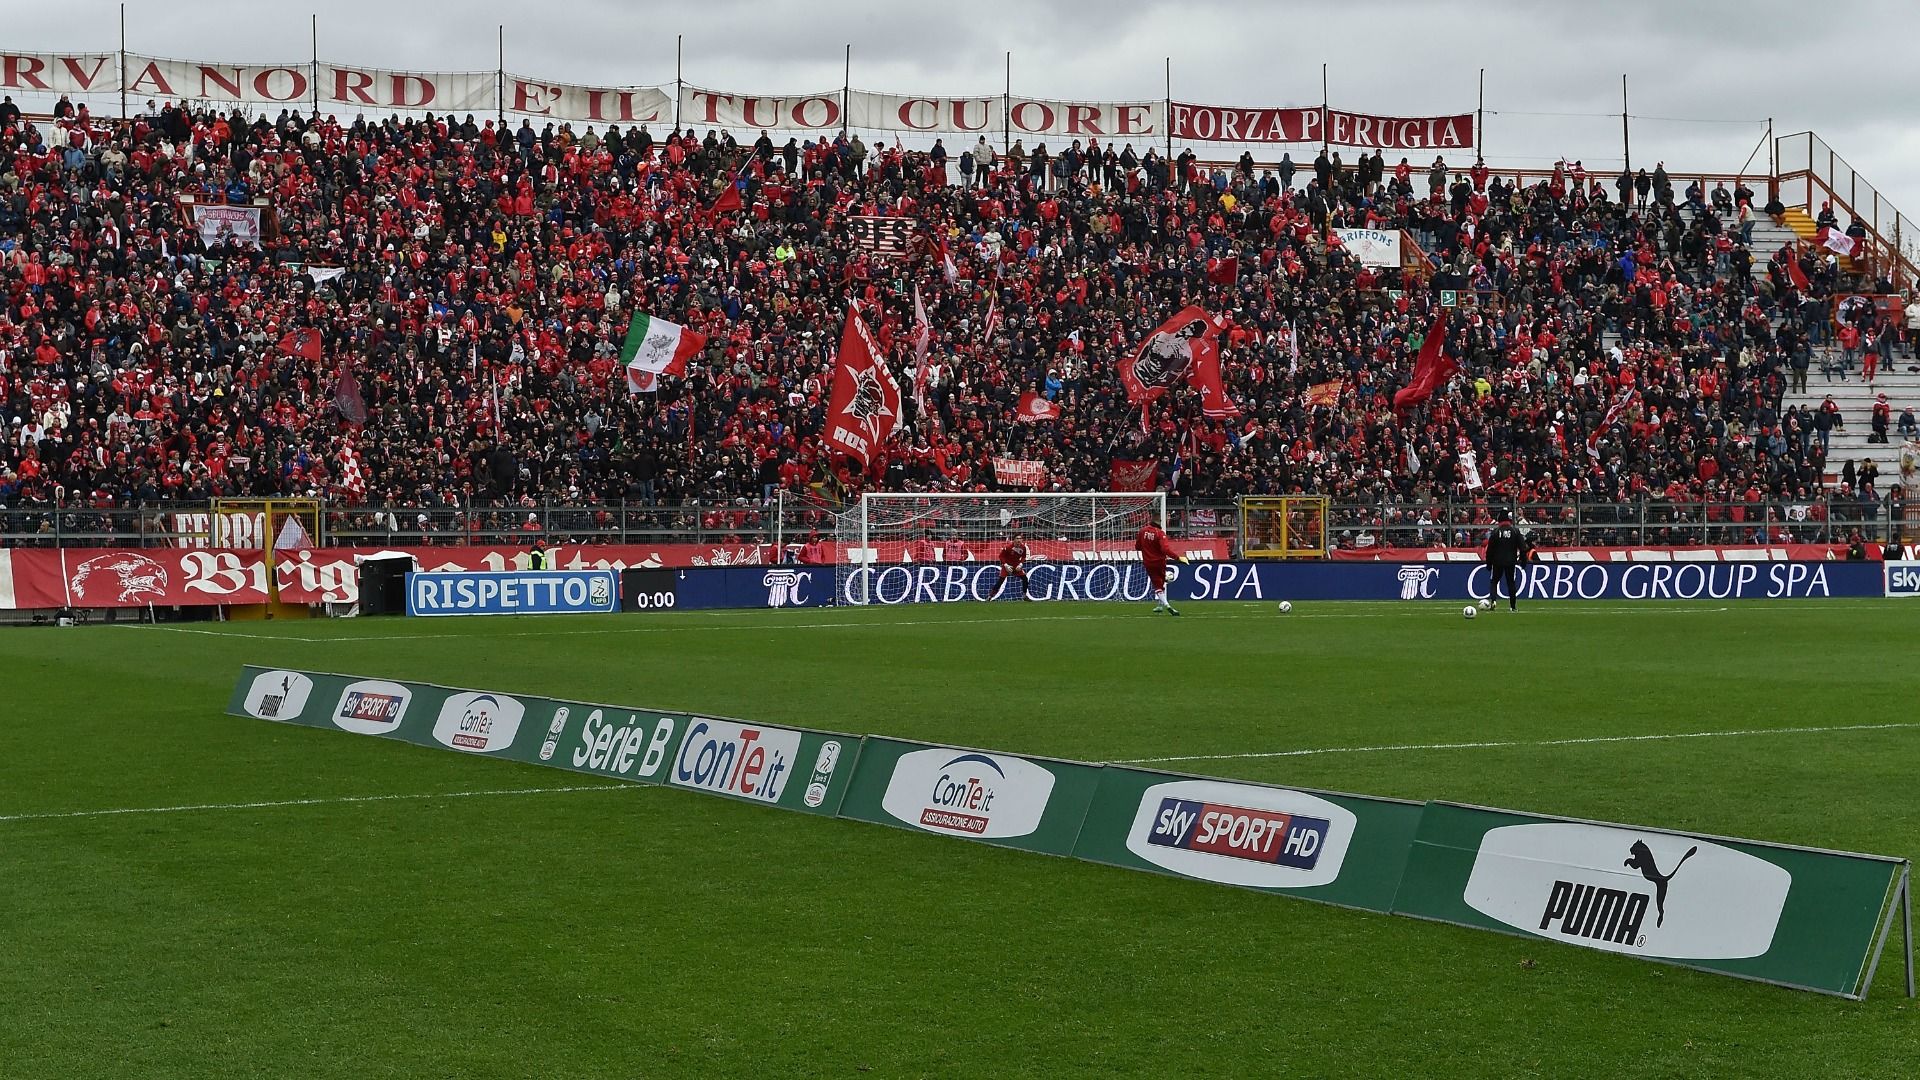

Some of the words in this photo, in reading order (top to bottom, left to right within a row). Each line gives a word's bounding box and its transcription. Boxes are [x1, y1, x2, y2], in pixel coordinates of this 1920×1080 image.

[196, 65, 436, 107] NORD
[585, 90, 659, 122] IL
[692, 91, 840, 128] TUO
[897, 99, 1154, 135] CUORE
[1172, 105, 1289, 140] FORZA
[1300, 110, 1463, 148] PERUGIA
[1340, 230, 1393, 247] GRIFFONS
[418, 576, 587, 609] RISPETTO
[844, 565, 1009, 606] CORBO
[1190, 563, 1263, 600] SPA
[1467, 563, 1609, 600] CORBO
[1621, 563, 1757, 600] GROUP
[1767, 562, 1830, 598] SPA
[1892, 567, 1920, 592] sky
[637, 591, 675, 609] 0:00
[343, 692, 359, 717] sky
[358, 697, 389, 718] SPORT
[387, 700, 399, 717] HD
[460, 709, 493, 735] ConTe.it
[572, 708, 644, 774] Serie
[637, 717, 675, 777] B
[678, 722, 785, 799] ConTe.it
[932, 774, 995, 812] ConTe.it
[923, 811, 968, 829] ASSICURAZIONE
[966, 818, 985, 831] AUTO
[1155, 801, 1196, 846] sky
[1196, 811, 1284, 853] SPORT
[1284, 826, 1320, 858] HD
[1539, 880, 1650, 946] PUMA
